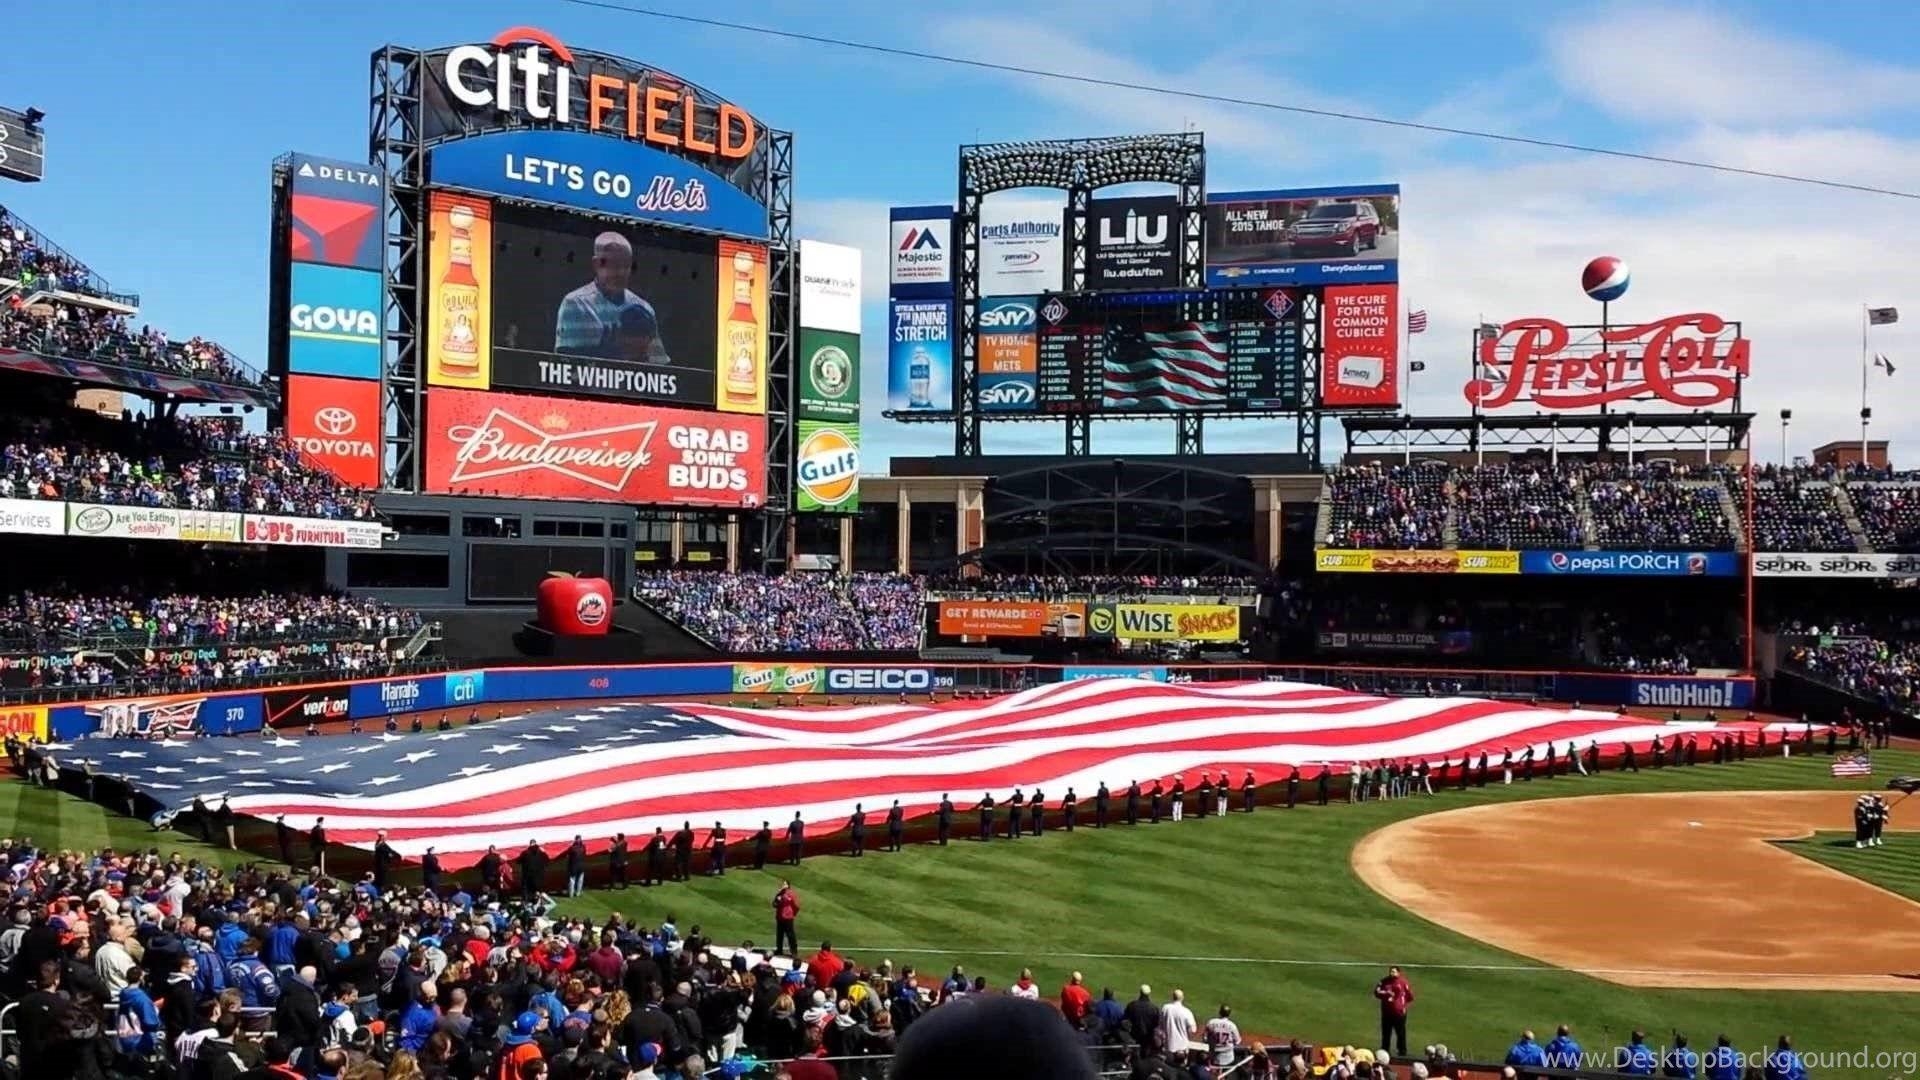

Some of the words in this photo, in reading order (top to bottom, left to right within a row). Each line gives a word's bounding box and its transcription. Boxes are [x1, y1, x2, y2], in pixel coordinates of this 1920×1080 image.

[445, 36, 570, 124] citi
[589, 73, 756, 160] FIELD
[320, 165, 379, 187] DELTA
[505, 154, 584, 190] LET'S
[593, 171, 631, 198] GO
[637, 175, 708, 213] Mets
[1226, 209, 1268, 222] ALL-NEW
[981, 222, 1010, 239] Parts
[1011, 220, 1061, 237] Authority
[1232, 222, 1254, 232] 2015
[1255, 219, 1285, 232] TAHOE
[898, 251, 943, 265] Majestic
[1103, 267, 1164, 278] liu.edu/fan
[1334, 296, 1355, 306] THE
[1357, 294, 1388, 305] CURE
[290, 303, 378, 335] GOYA
[911, 311, 947, 326] INNING
[979, 310, 1026, 327] SNY
[1337, 307, 1362, 317] FOR
[1363, 305, 1385, 315] THE
[1333, 316, 1389, 328] COMMON
[895, 325, 947, 342] STRETCH
[985, 336, 1001, 347] TV
[1001, 335, 1029, 346] HOME
[1336, 327, 1385, 338] CUBICLE
[992, 360, 1021, 371] METS
[538, 361, 572, 385] THE
[576, 364, 677, 395] WHIPTONES
[979, 389, 1025, 404] SNY
[293, 437, 376, 458] TOYOTA
[667, 425, 749, 453] GRAB
[448, 425, 652, 471] Budweiser
[681, 449, 736, 467] SOME
[800, 452, 856, 481] Gulf
[668, 465, 748, 491] BUDS
[0, 510, 52, 529] Services
[116, 513, 131, 524] Are
[131, 511, 148, 522] You
[149, 511, 176, 527] Eating
[296, 529, 345, 545] FURNITURE
[1319, 553, 1370, 567] SUBWAY
[1463, 553, 1517, 568] SUBWAY
[1570, 554, 1615, 572] pepsi
[1618, 554, 1680, 571] PORCH
[946, 608, 969, 619] GET
[1120, 609, 1173, 633] WISE
[1177, 608, 1237, 637] SNACKS
[198, 649, 217, 659] Deck
[3, 657, 31, 671] Party
[50, 655, 73, 667] Deck
[742, 669, 773, 687] Gulf
[785, 670, 816, 687] Gulf
[829, 668, 929, 689] GEICO
[933, 676, 954, 687] 390
[382, 680, 420, 702] Harrah's
[454, 677, 475, 701] citi
[1638, 680, 1734, 708] StubHub!
[226, 707, 245, 721] 370
[304, 696, 349, 717] verizon
